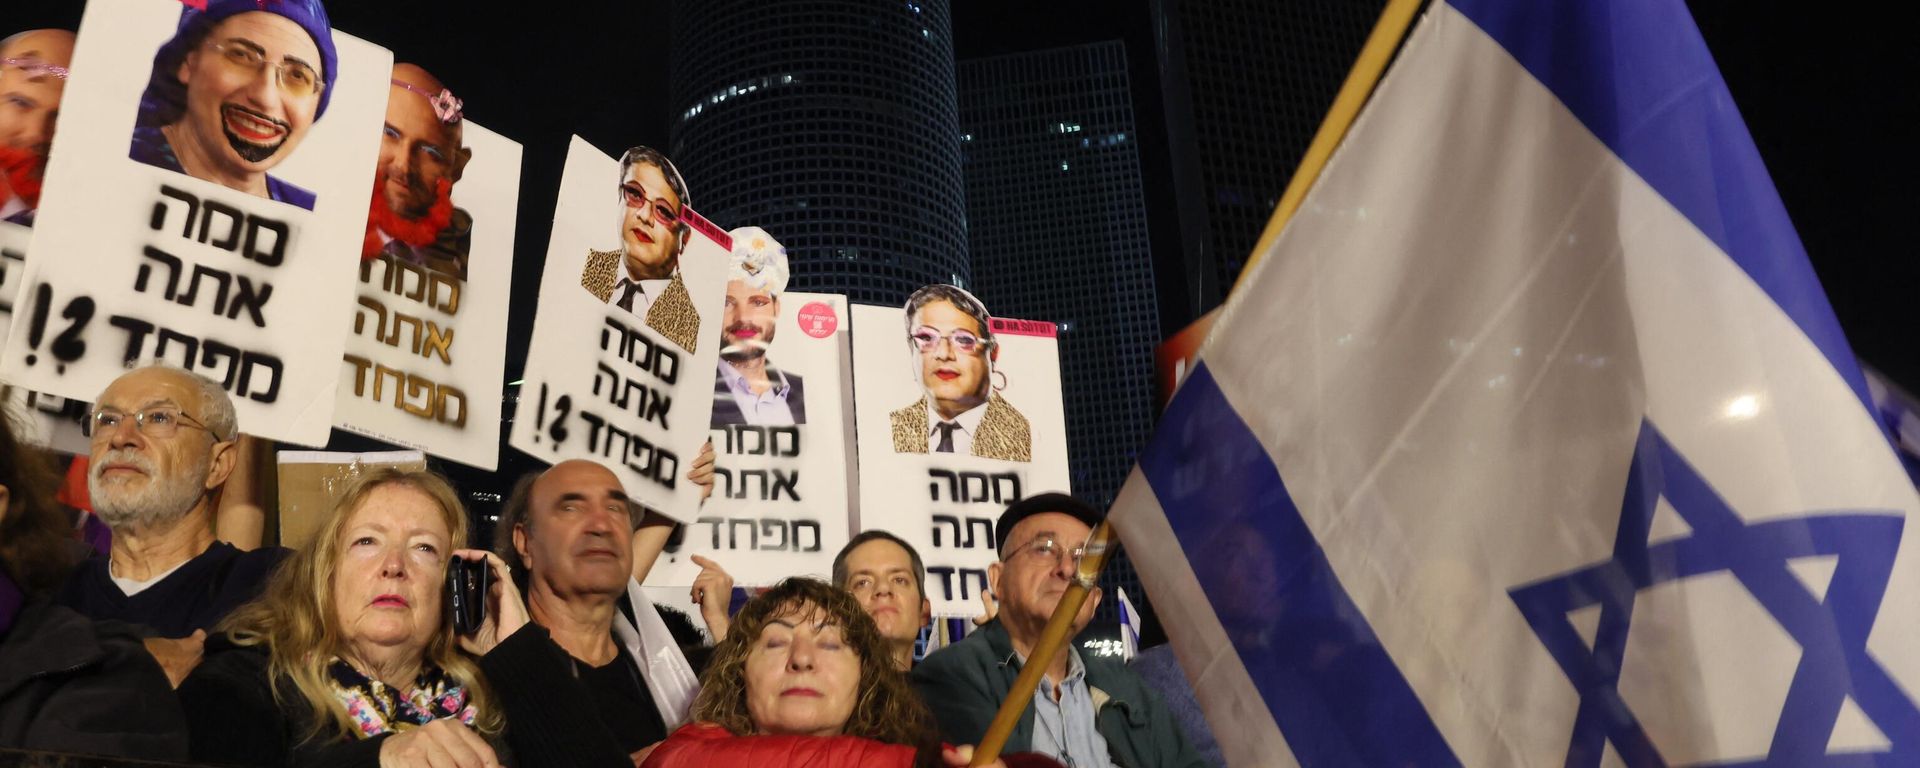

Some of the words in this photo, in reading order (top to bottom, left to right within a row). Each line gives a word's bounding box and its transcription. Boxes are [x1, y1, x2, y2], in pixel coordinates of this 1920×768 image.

[150, 184, 289, 267] ממה
[134, 245, 273, 328] אתה
[361, 253, 461, 316] ממה
[354, 295, 454, 365] אתה
[601, 316, 679, 386] ממה
[343, 353, 467, 429] מפחד
[593, 361, 672, 431] אתה
[928, 468, 1021, 506] ממה
[932, 514, 995, 549] תה
